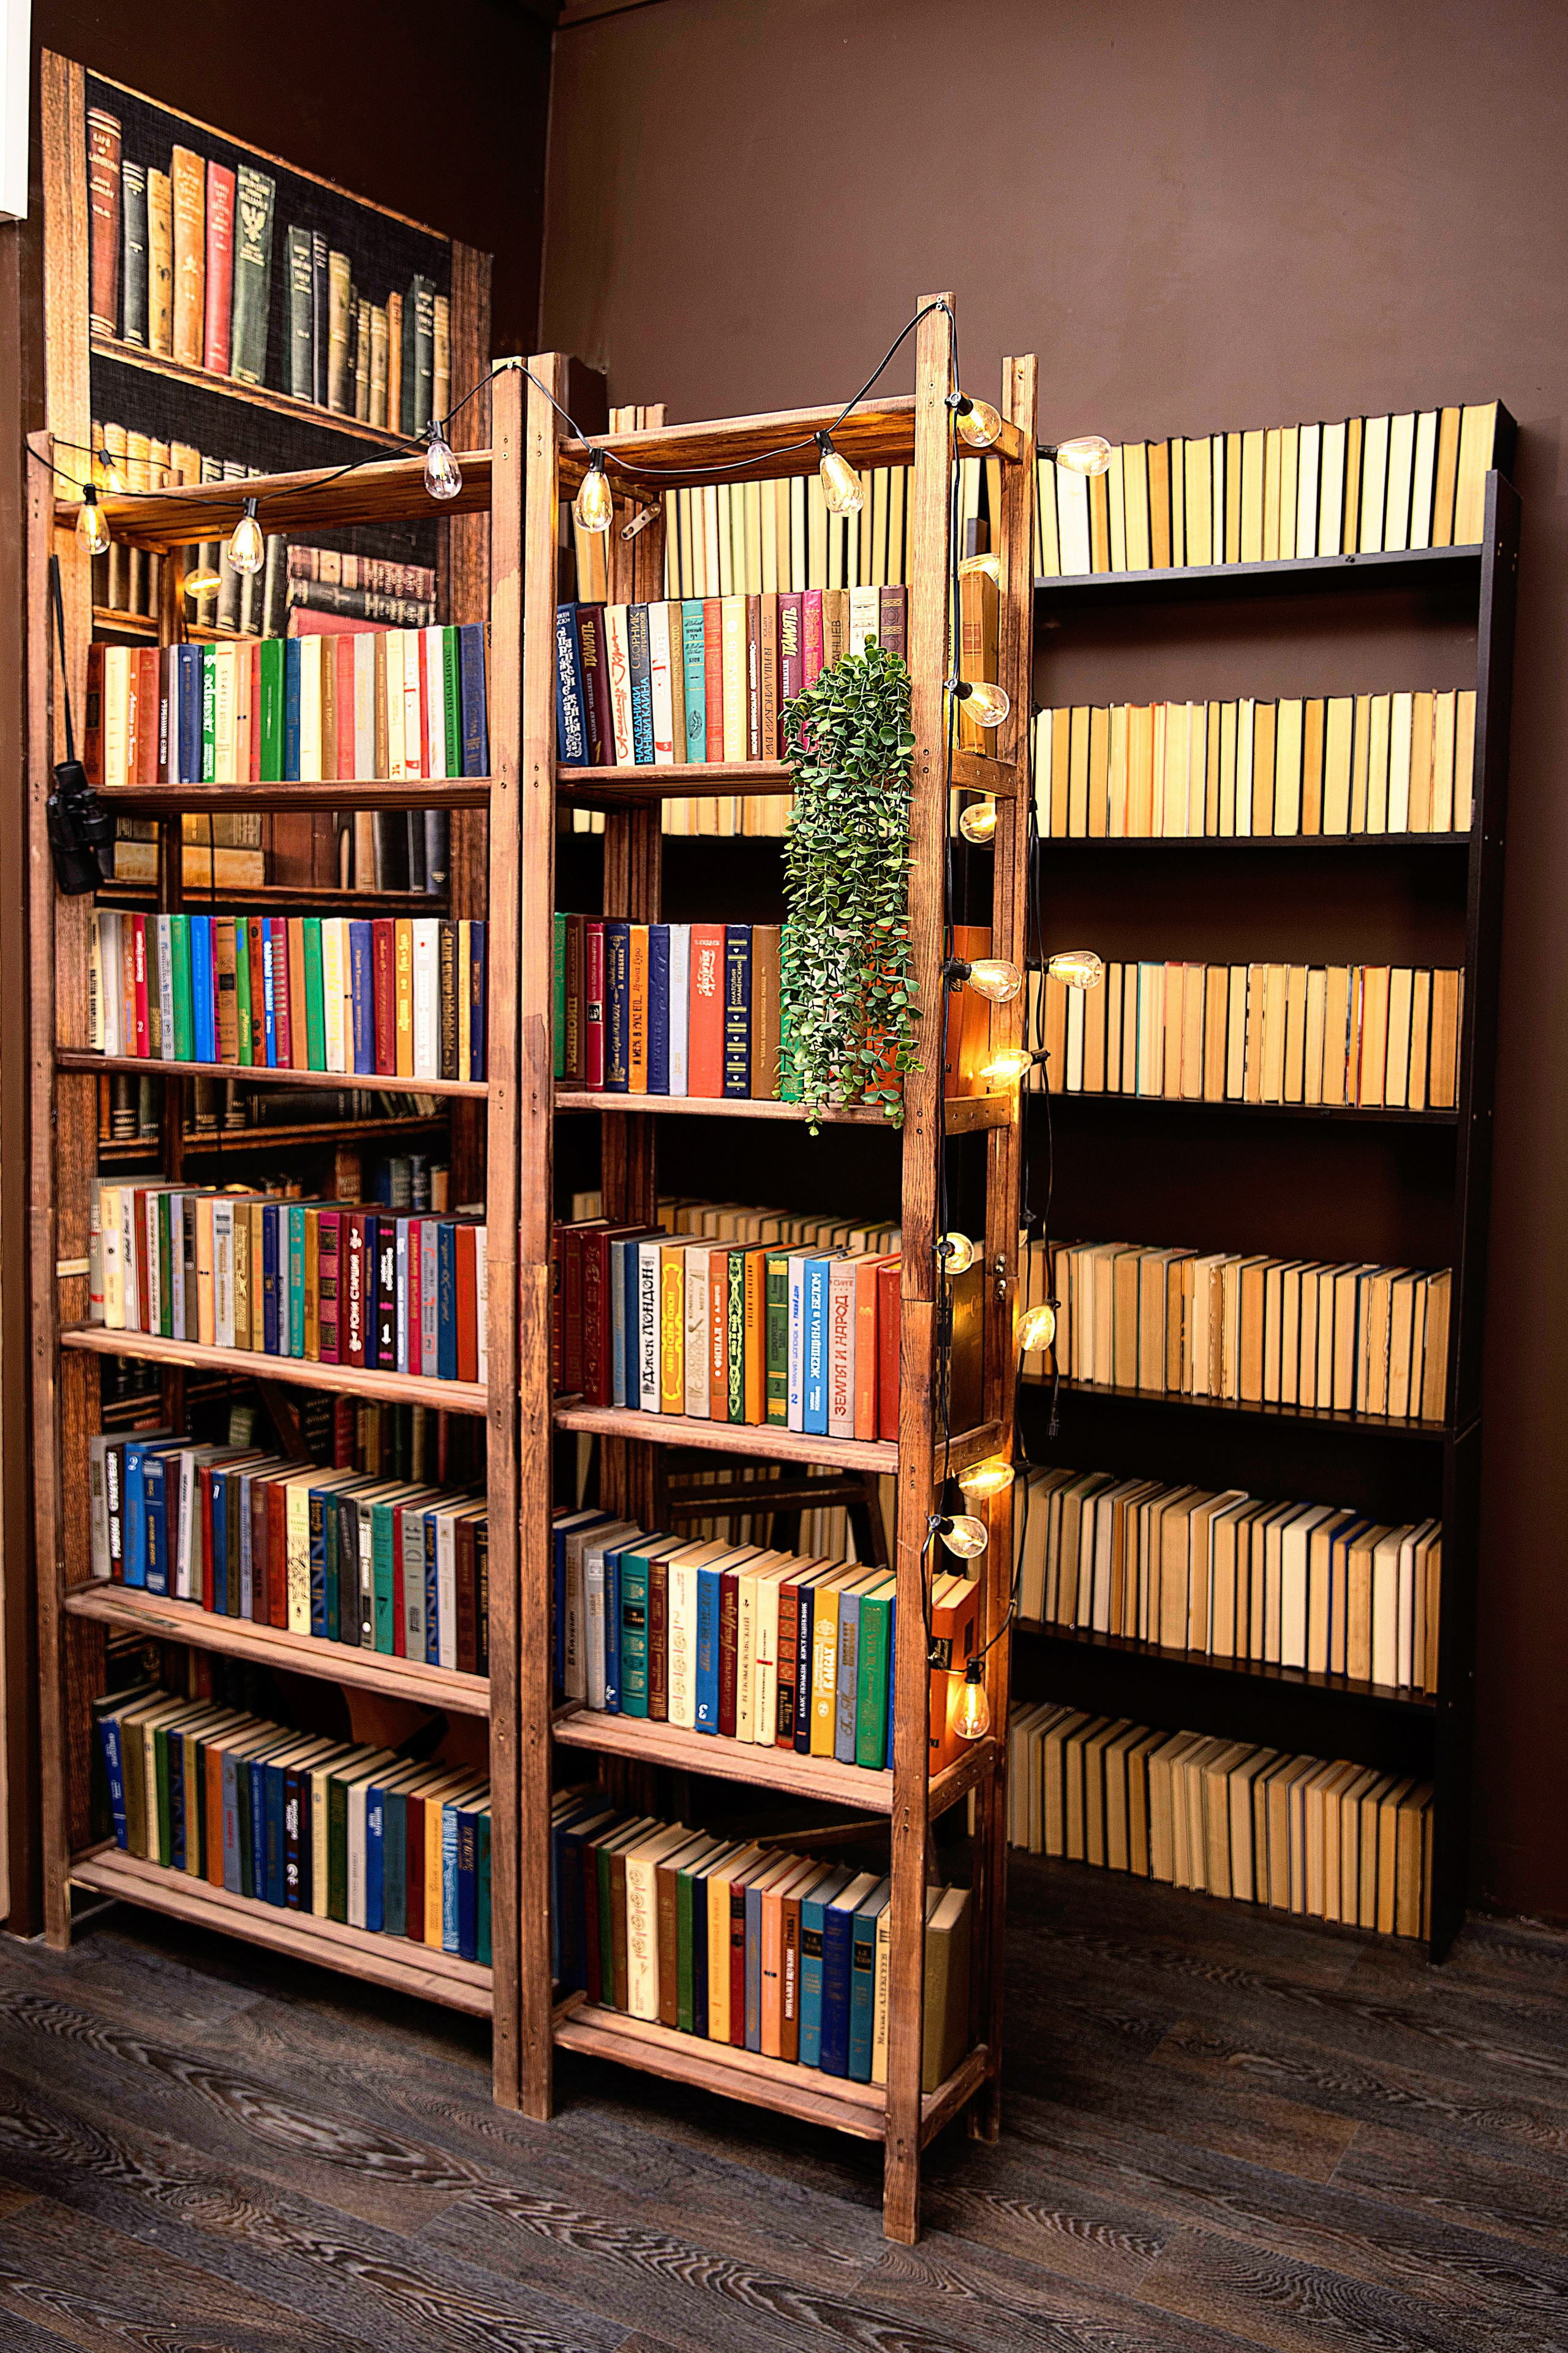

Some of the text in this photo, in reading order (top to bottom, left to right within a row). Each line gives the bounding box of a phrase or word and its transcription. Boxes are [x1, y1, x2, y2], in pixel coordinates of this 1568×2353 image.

[581, 621, 597, 669] ПАМЯТЬ
[630, 613, 641, 669] СБОРНИК
[781, 607, 798, 657] ПАМЯТЬ
[831, 620, 842, 671] ЗАНЦЕВ
[632, 687, 644, 763] НАСЛЕДНИКИ
[764, 648, 774, 755] ВЕРШАЛИНСКИЙ РАЙ
[642, 719, 654, 763] ВАНЬКИ
[633, 1040, 642, 1058] МЕРА
[812, 1272, 821, 1310] БЕЛОМ
[641, 1268, 654, 1384] Джек ЛОНДОН
[714, 1327, 723, 1368] ФИНАЛ
[810, 1320, 822, 1379] ЖЕНЩИНА
[834, 1296, 849, 1416] ЗЕМЛЯ И НАРОД
[791, 1393, 798, 1405] 2
[127, 1456, 138, 1471] 2
[698, 1704, 708, 1720] 3
